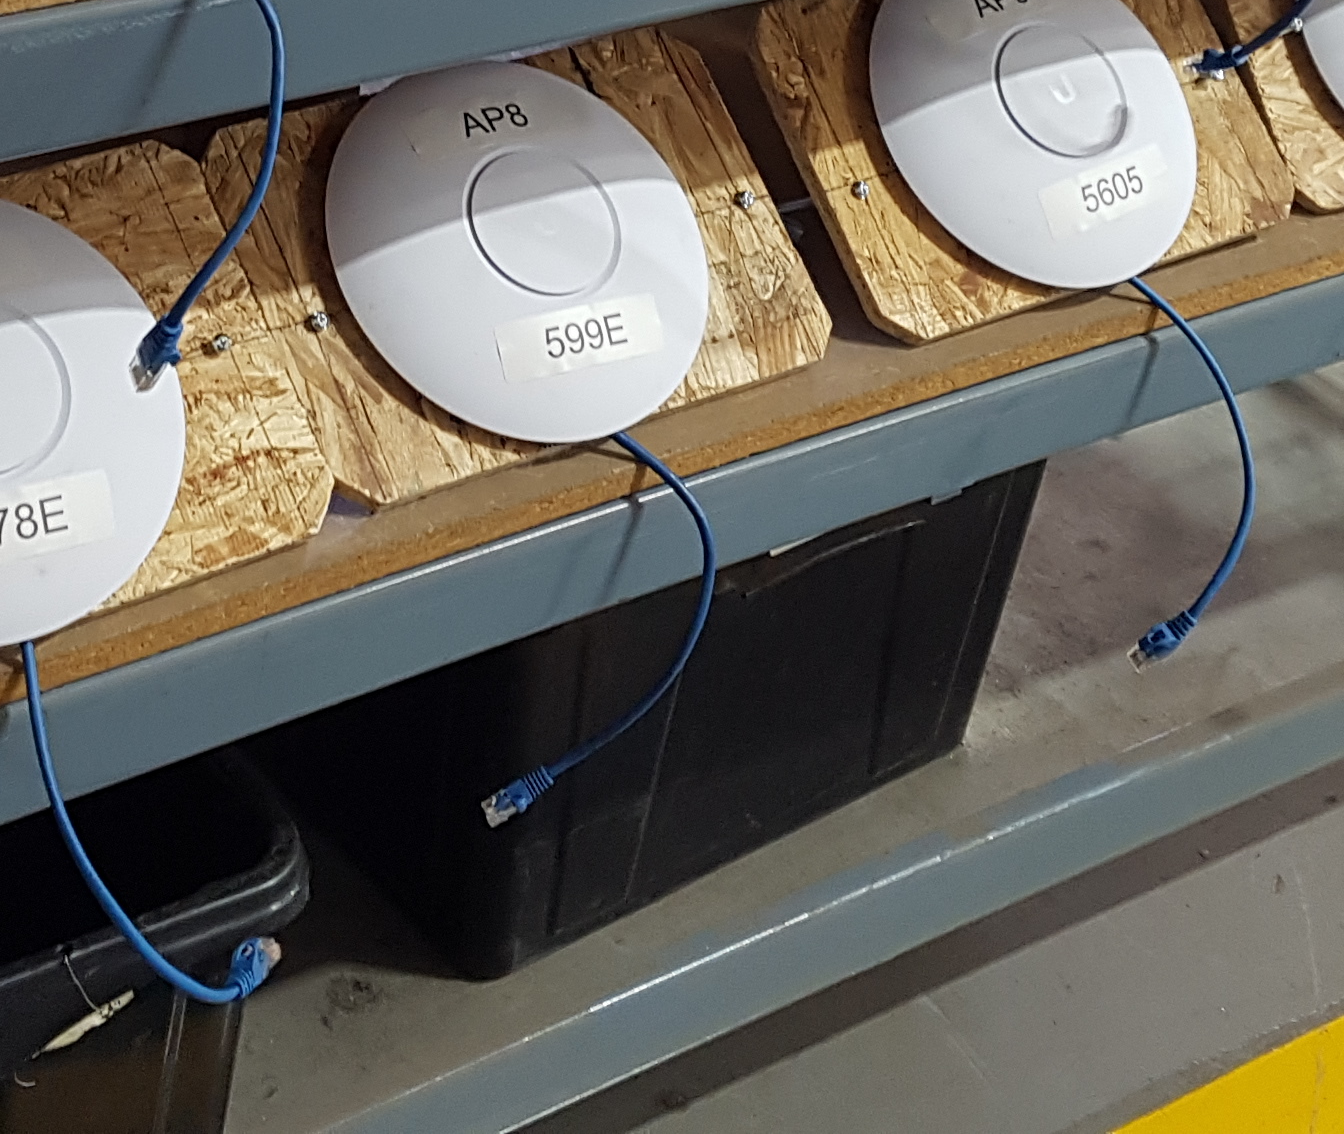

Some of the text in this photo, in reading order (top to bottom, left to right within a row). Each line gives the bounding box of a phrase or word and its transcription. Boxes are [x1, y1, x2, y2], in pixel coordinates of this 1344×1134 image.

[463, 103, 529, 138] AP8
[1081, 165, 1143, 213] 5605
[545, 312, 628, 359] 599E
